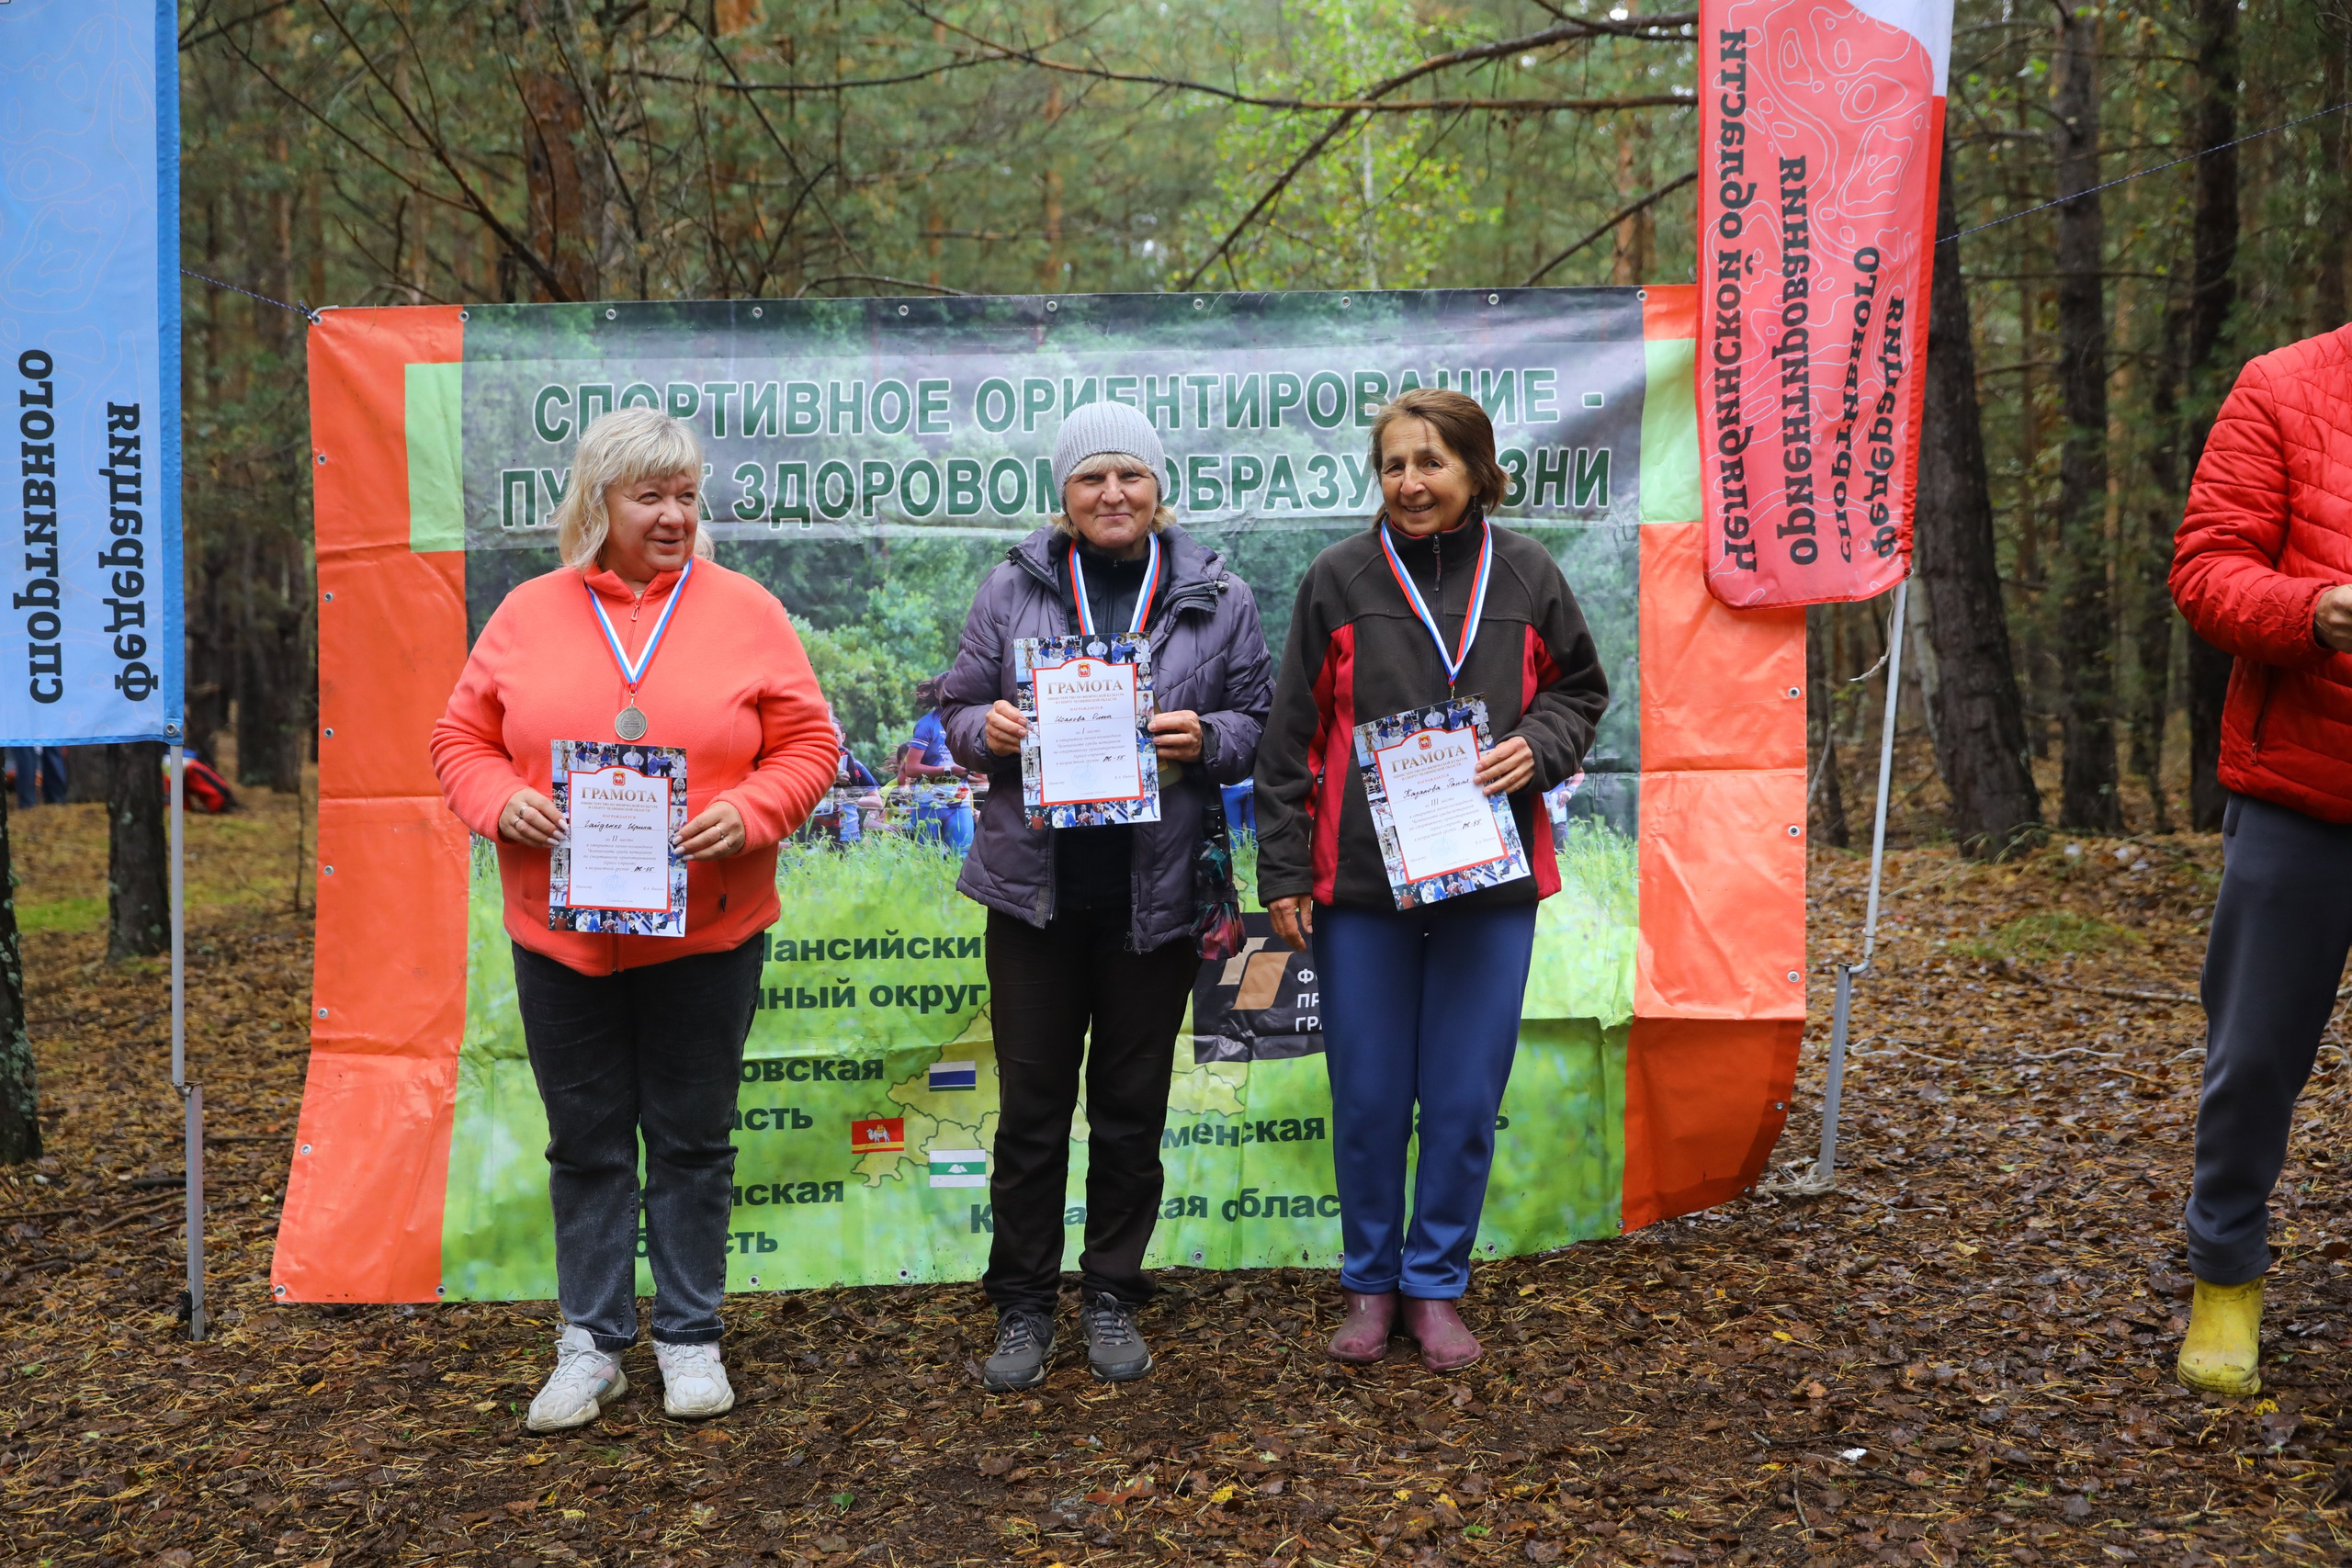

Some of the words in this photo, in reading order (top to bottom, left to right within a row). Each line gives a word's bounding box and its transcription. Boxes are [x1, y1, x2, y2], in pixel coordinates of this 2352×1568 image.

[732, 457, 1067, 530] ЗДОРОВОМ
[1048, 680, 1123, 694] ГРАМОТА
[1392, 745, 1465, 773] ГРАМОТА
[582, 788, 657, 802] ГРАМОТА
[764, 929, 981, 963] ансийски
[869, 984, 987, 1014] округ
[741, 1059, 884, 1082] овская
[1161, 1117, 1326, 1149] менская
[1222, 1188, 1341, 1223] облас
